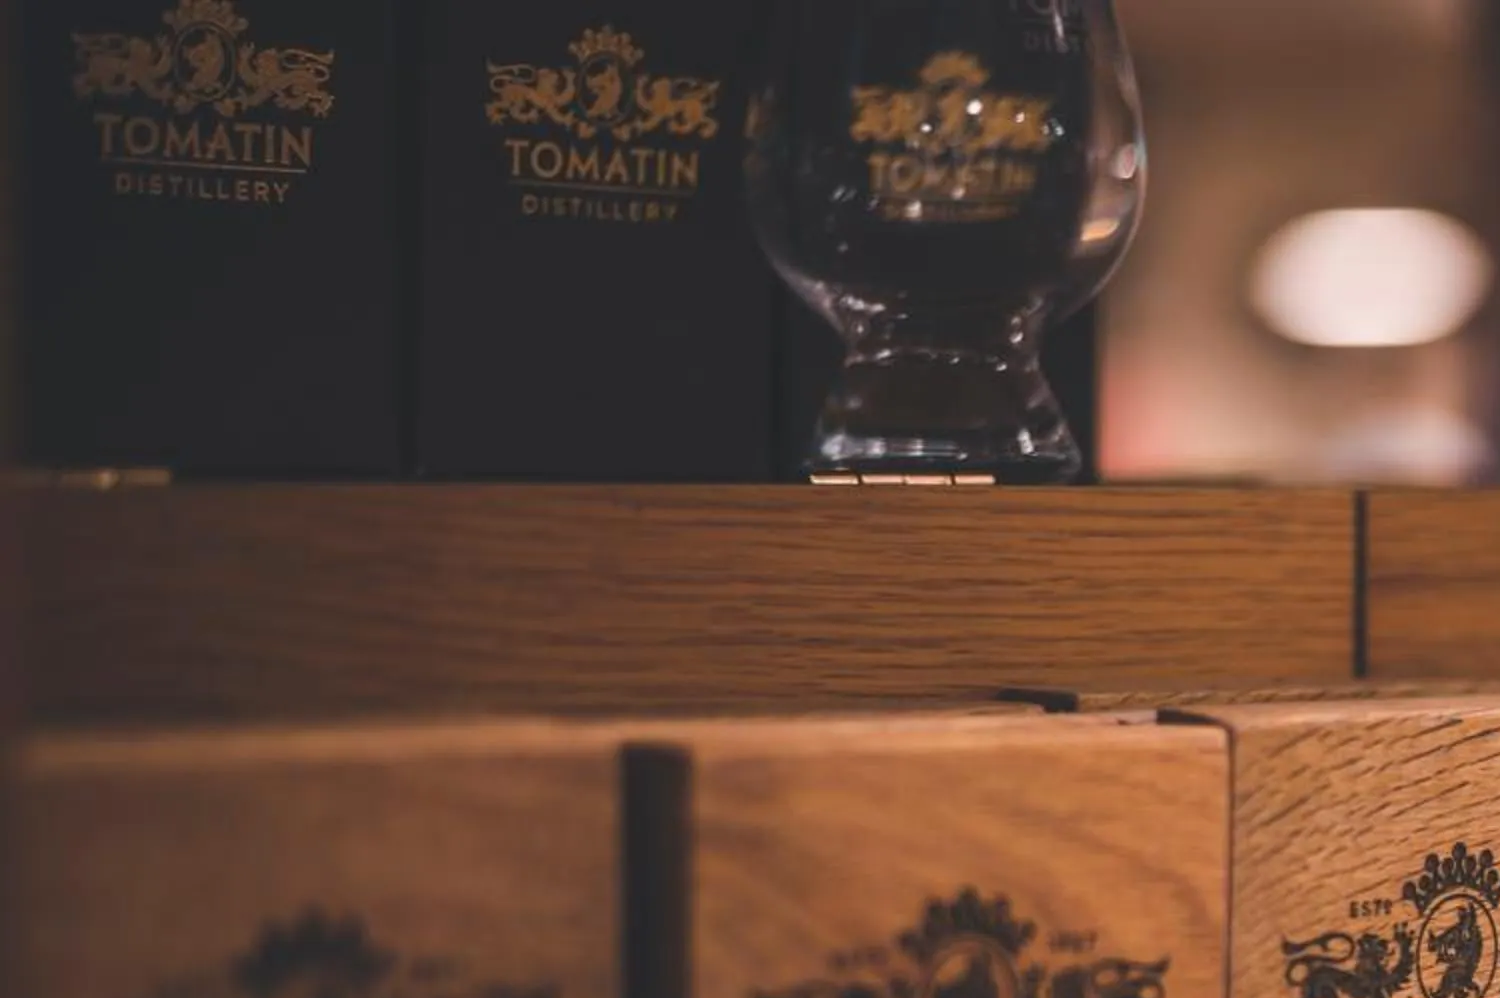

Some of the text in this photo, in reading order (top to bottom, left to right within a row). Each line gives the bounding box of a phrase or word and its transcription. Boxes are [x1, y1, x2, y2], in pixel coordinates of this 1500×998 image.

[94, 113, 313, 168] TOMATIN
[504, 138, 699, 188] TOMATIN
[115, 172, 292, 205] DISTILLERY
[521, 194, 679, 223] DISTILLERY
